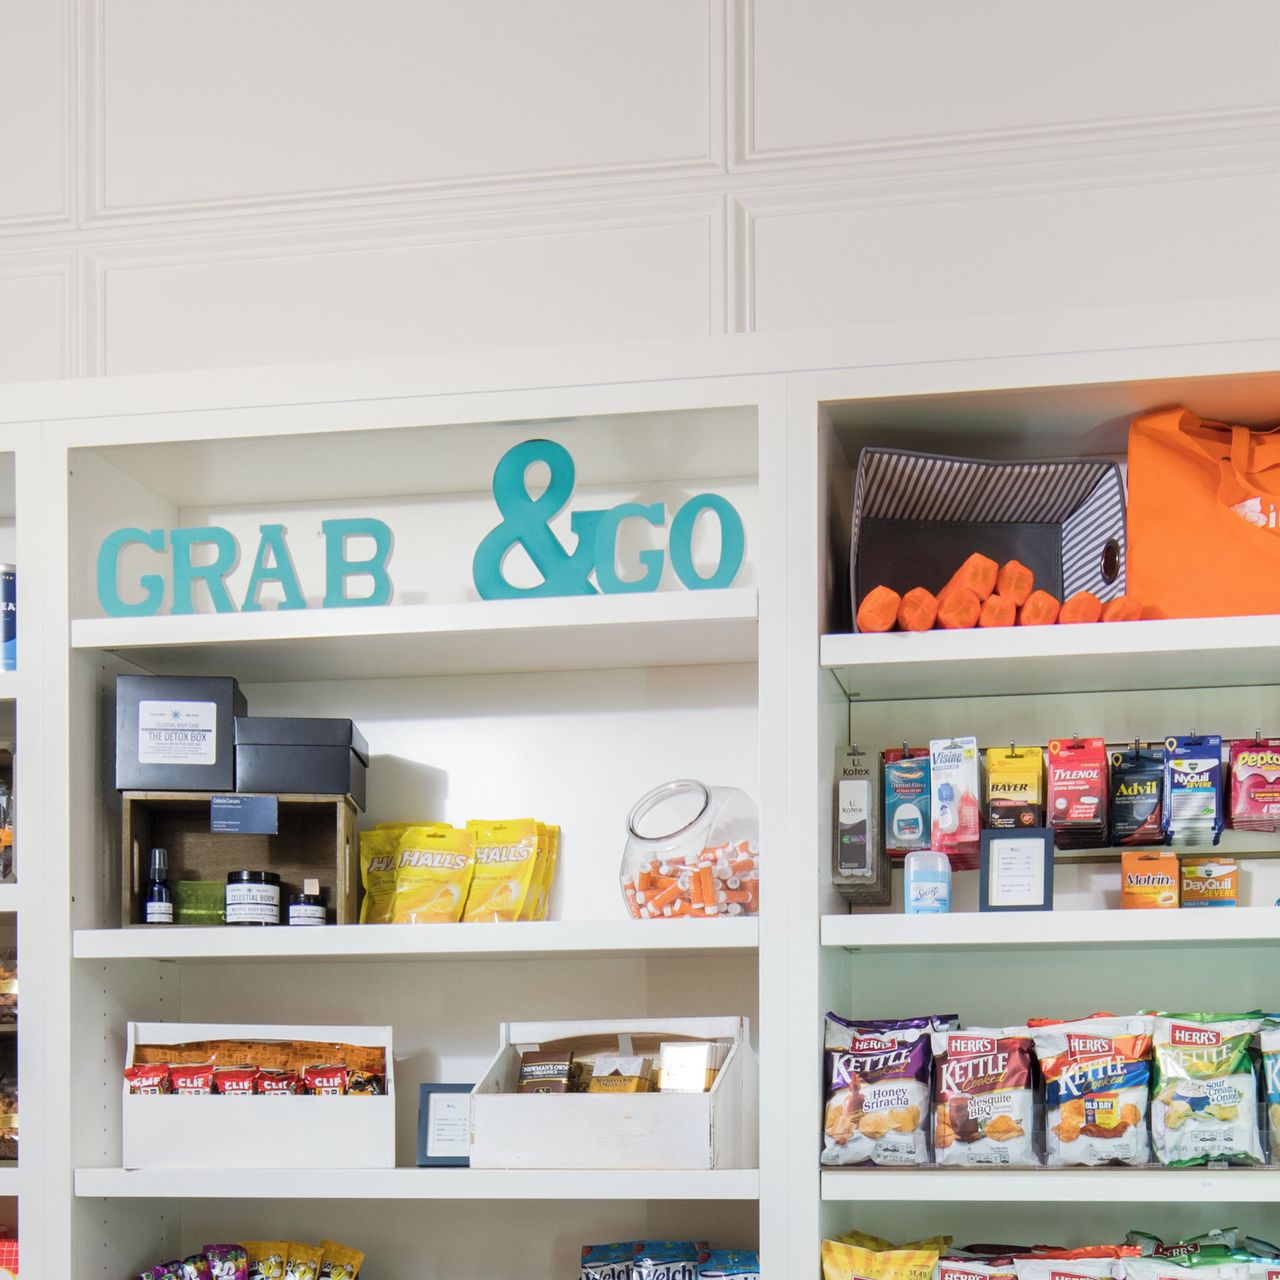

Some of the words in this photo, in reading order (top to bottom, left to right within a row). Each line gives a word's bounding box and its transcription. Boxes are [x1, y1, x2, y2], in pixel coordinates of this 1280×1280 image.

[96, 516, 396, 619] GRAB
[472, 438, 610, 600] &
[593, 492, 747, 595] GO
[148, 730, 163, 741] THE
[163, 731, 189, 742] DETOX
[190, 731, 207, 743] BOX
[1053, 769, 1099, 781] TYLENOL
[1173, 771, 1211, 785] NyQuil
[991, 783, 1029, 792] BAYER
[1116, 781, 1158, 796] Advil
[1186, 780, 1213, 789] SEVERE
[400, 850, 469, 870] HALLS
[1125, 872, 1170, 887] Motrin
[1183, 877, 1233, 896] DayQuil
[259, 894, 275, 903] BODY
[1203, 888, 1236, 898] SEVERE
[1174, 1028, 1218, 1045] HERR'S
[950, 1037, 992, 1055] HERR'S
[1070, 1037, 1110, 1053] HERR'S
[554, 1063, 570, 1071] OWN
[831, 1047, 912, 1085] KETTLE
[314, 1075, 342, 1088] CLIF
[940, 1053, 1009, 1096] KETTLE
[1057, 1055, 1128, 1097] KETTLE
[177, 1076, 205, 1088] CLIF
[224, 1080, 251, 1091] CLIF
[961, 1071, 1008, 1093] Cooked
[1081, 1072, 1125, 1094] Cooked
[1206, 1078, 1227, 1091] Sour
[872, 1086, 909, 1100] Honey
[1208, 1085, 1234, 1098] Cream
[1216, 1092, 1240, 1104] Onion
[862, 1096, 910, 1113] Sriracha
[968, 1093, 1012, 1112] Mesquite
[1085, 1098, 1099, 1111] OLD
[1100, 1099, 1114, 1111] BAY
[969, 1104, 993, 1119] BBQ
